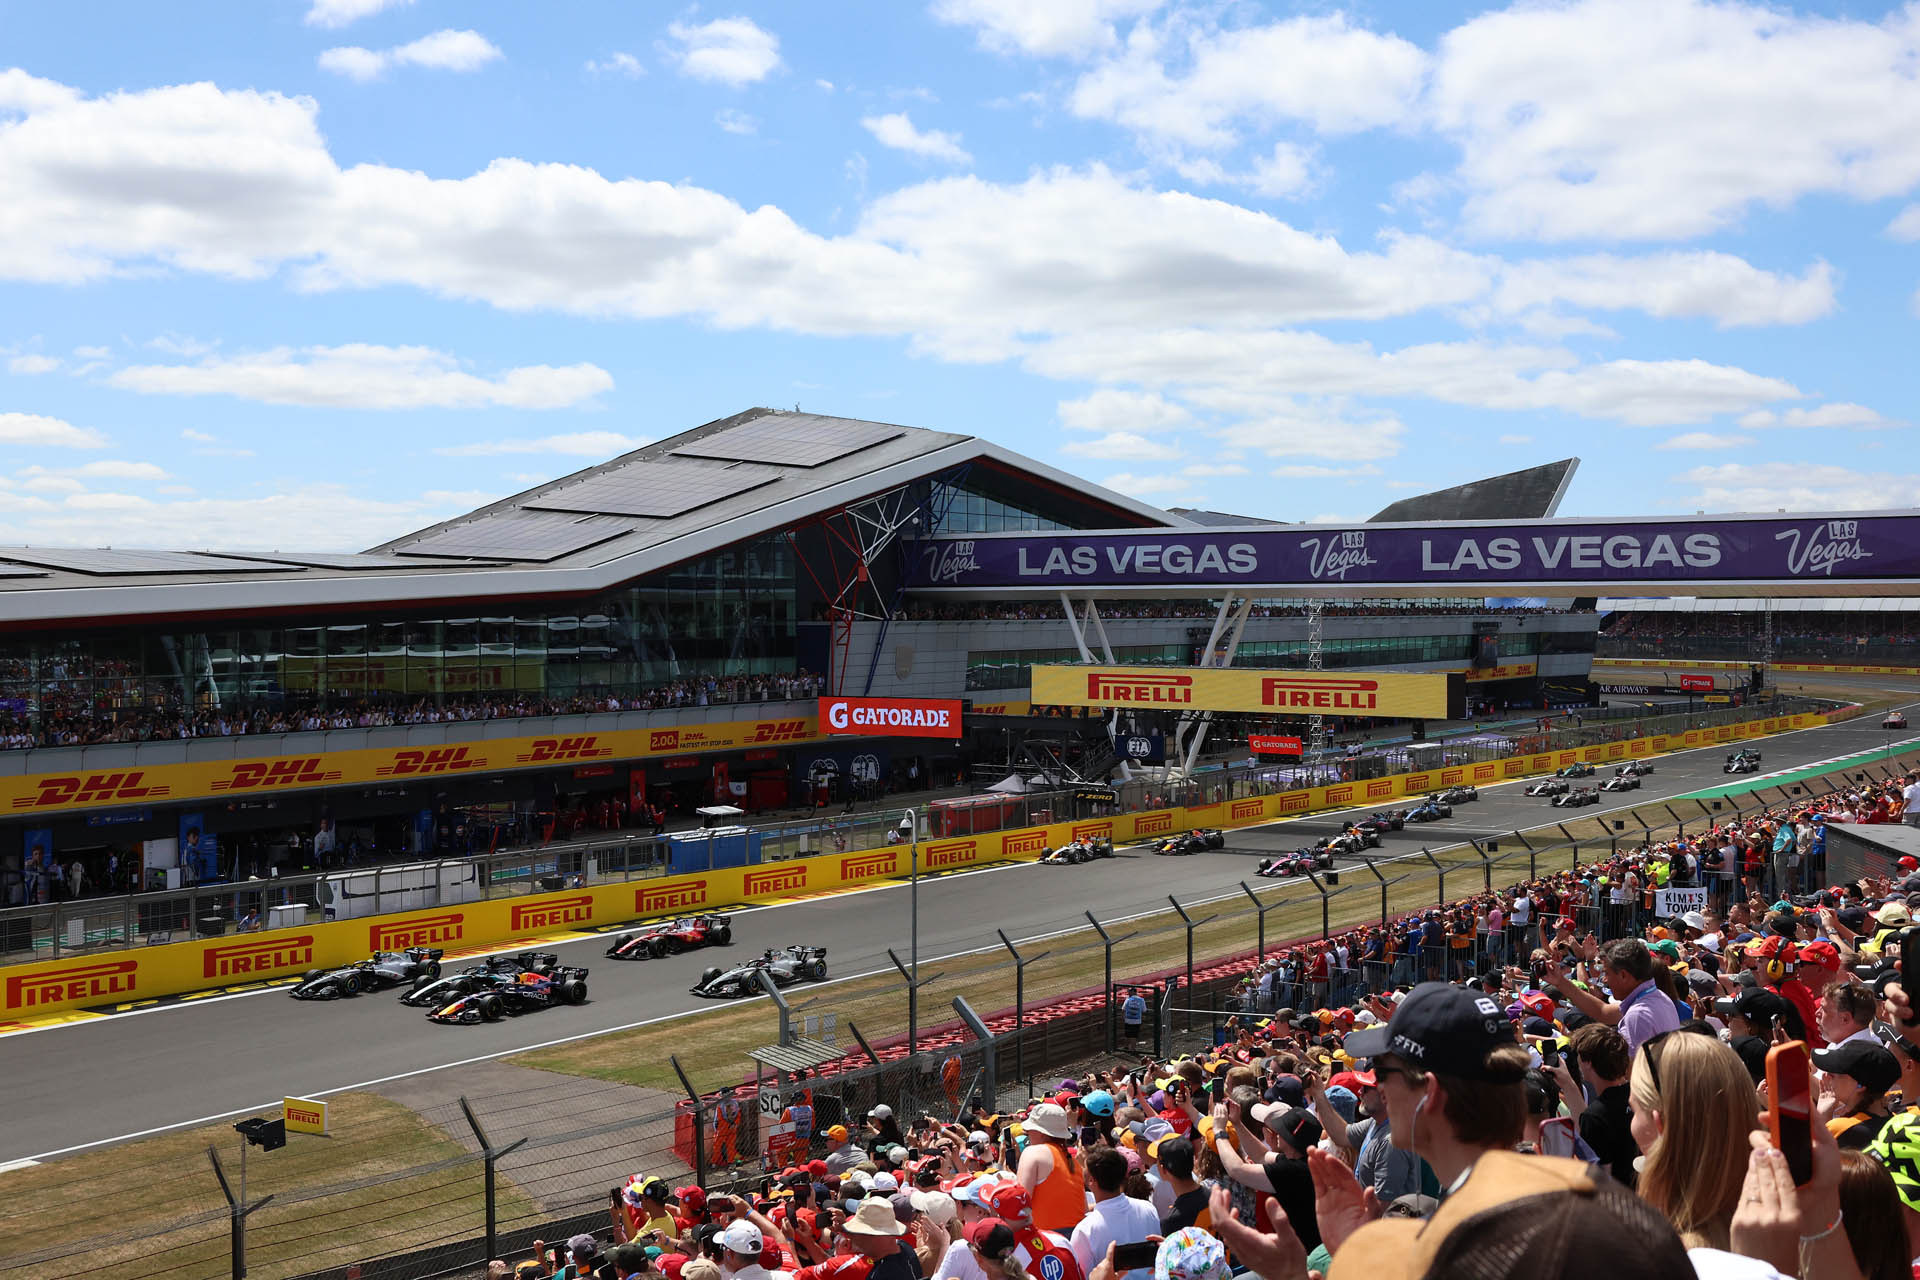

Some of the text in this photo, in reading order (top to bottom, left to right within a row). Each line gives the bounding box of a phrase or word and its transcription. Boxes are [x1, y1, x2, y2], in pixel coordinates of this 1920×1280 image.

[1343, 532, 1364, 548] LAS
[1828, 521, 1857, 539] LAS
[956, 541, 974, 555] LAS
[1019, 543, 1259, 576] LAS VEGAS
[1300, 537, 1377, 579] Vegas
[1422, 533, 1721, 571] LAS VEGAS
[1776, 524, 1873, 575] Vegas
[924, 544, 980, 582] Vegas
[1088, 674, 1192, 703] PIRELLI
[1262, 678, 1378, 708] PIRELLI
[1613, 685, 1649, 694] AIRWAYS
[829, 702, 950, 729] G GATORADE
[684, 732, 705, 741] DHL
[755, 720, 808, 742] DHL
[531, 737, 599, 762] DHL
[1127, 739, 1149, 755] FIA
[1253, 740, 1298, 749] G GATORADE
[392, 747, 473, 775] DHL
[230, 759, 325, 790] DHL
[1406, 775, 1429, 791] PIRELLI
[1442, 770, 1462, 784] PIRELLI
[36, 772, 150, 806] DHL
[1086, 792, 1113, 801] ZERO
[1326, 787, 1352, 803] PIRELLI
[1368, 781, 1392, 797] PIRELLI
[1232, 800, 1264, 820] PIRELLI
[1280, 793, 1309, 811] PIRELLI
[1135, 813, 1171, 834] PIRELLI
[926, 841, 976, 866] PIRELLI
[1002, 831, 1047, 855] PIRELLI
[841, 853, 896, 880] PIRELLI
[744, 866, 807, 899] PIRELLI
[636, 880, 706, 912] PIRELLI
[512, 896, 592, 931] PIRELLI
[370, 914, 464, 952] PIRELLI
[204, 936, 313, 978] PIRELLI
[7, 961, 138, 1008] PIRELLI
[522, 991, 548, 1000] ORACLE
[1402, 1037, 1426, 1059] FTX
[760, 1092, 780, 1114] SC
[288, 1108, 320, 1124] PIRELLI
[1044, 1256, 1060, 1280] hp
